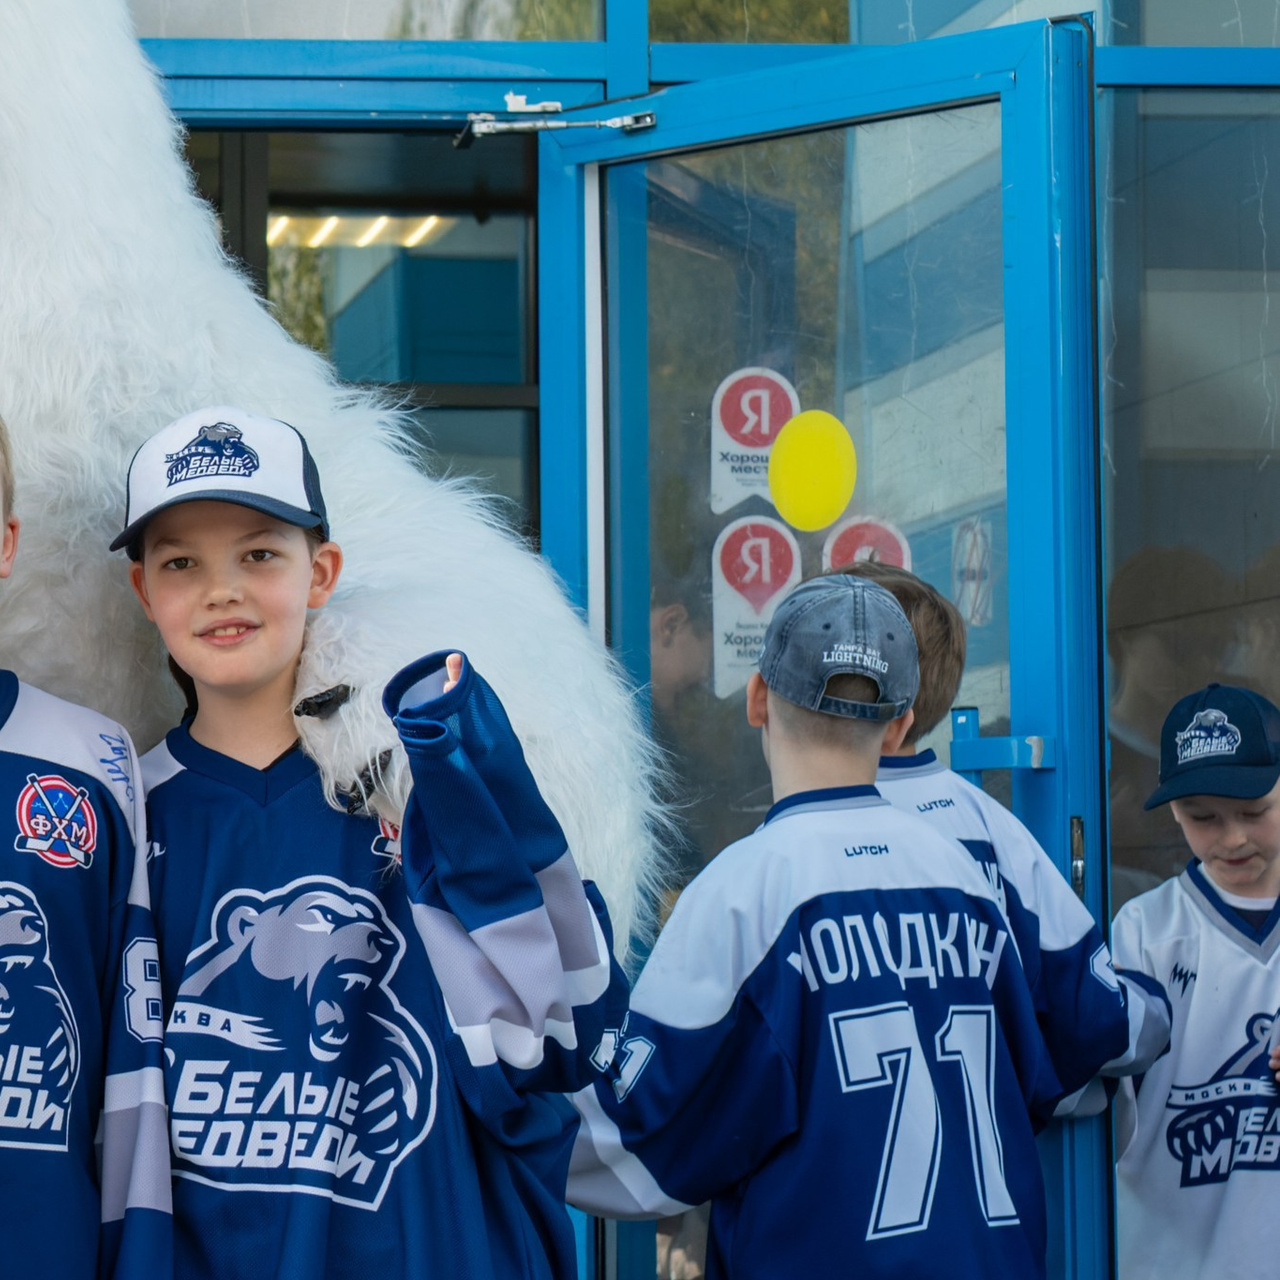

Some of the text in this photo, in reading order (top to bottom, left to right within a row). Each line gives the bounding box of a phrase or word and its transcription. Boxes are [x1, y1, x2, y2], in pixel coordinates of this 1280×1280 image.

[189, 455, 243, 469] БЕЛЫЕ
[171, 465, 250, 484] МЕДВЕДИ
[822, 651, 889, 674] LIGHTNING
[916, 798, 955, 813] LUTCH
[29, 813, 88, 847] ФХМ
[844, 844, 890, 858] LUTCH
[172, 1009, 233, 1033] КВА
[172, 1059, 361, 1127] БЕЛЫЕ
[1184, 1081, 1253, 1102] МОСКВ
[828, 1001, 1021, 1242] 71
[171, 1119, 376, 1186] ЕДВЕДИ
